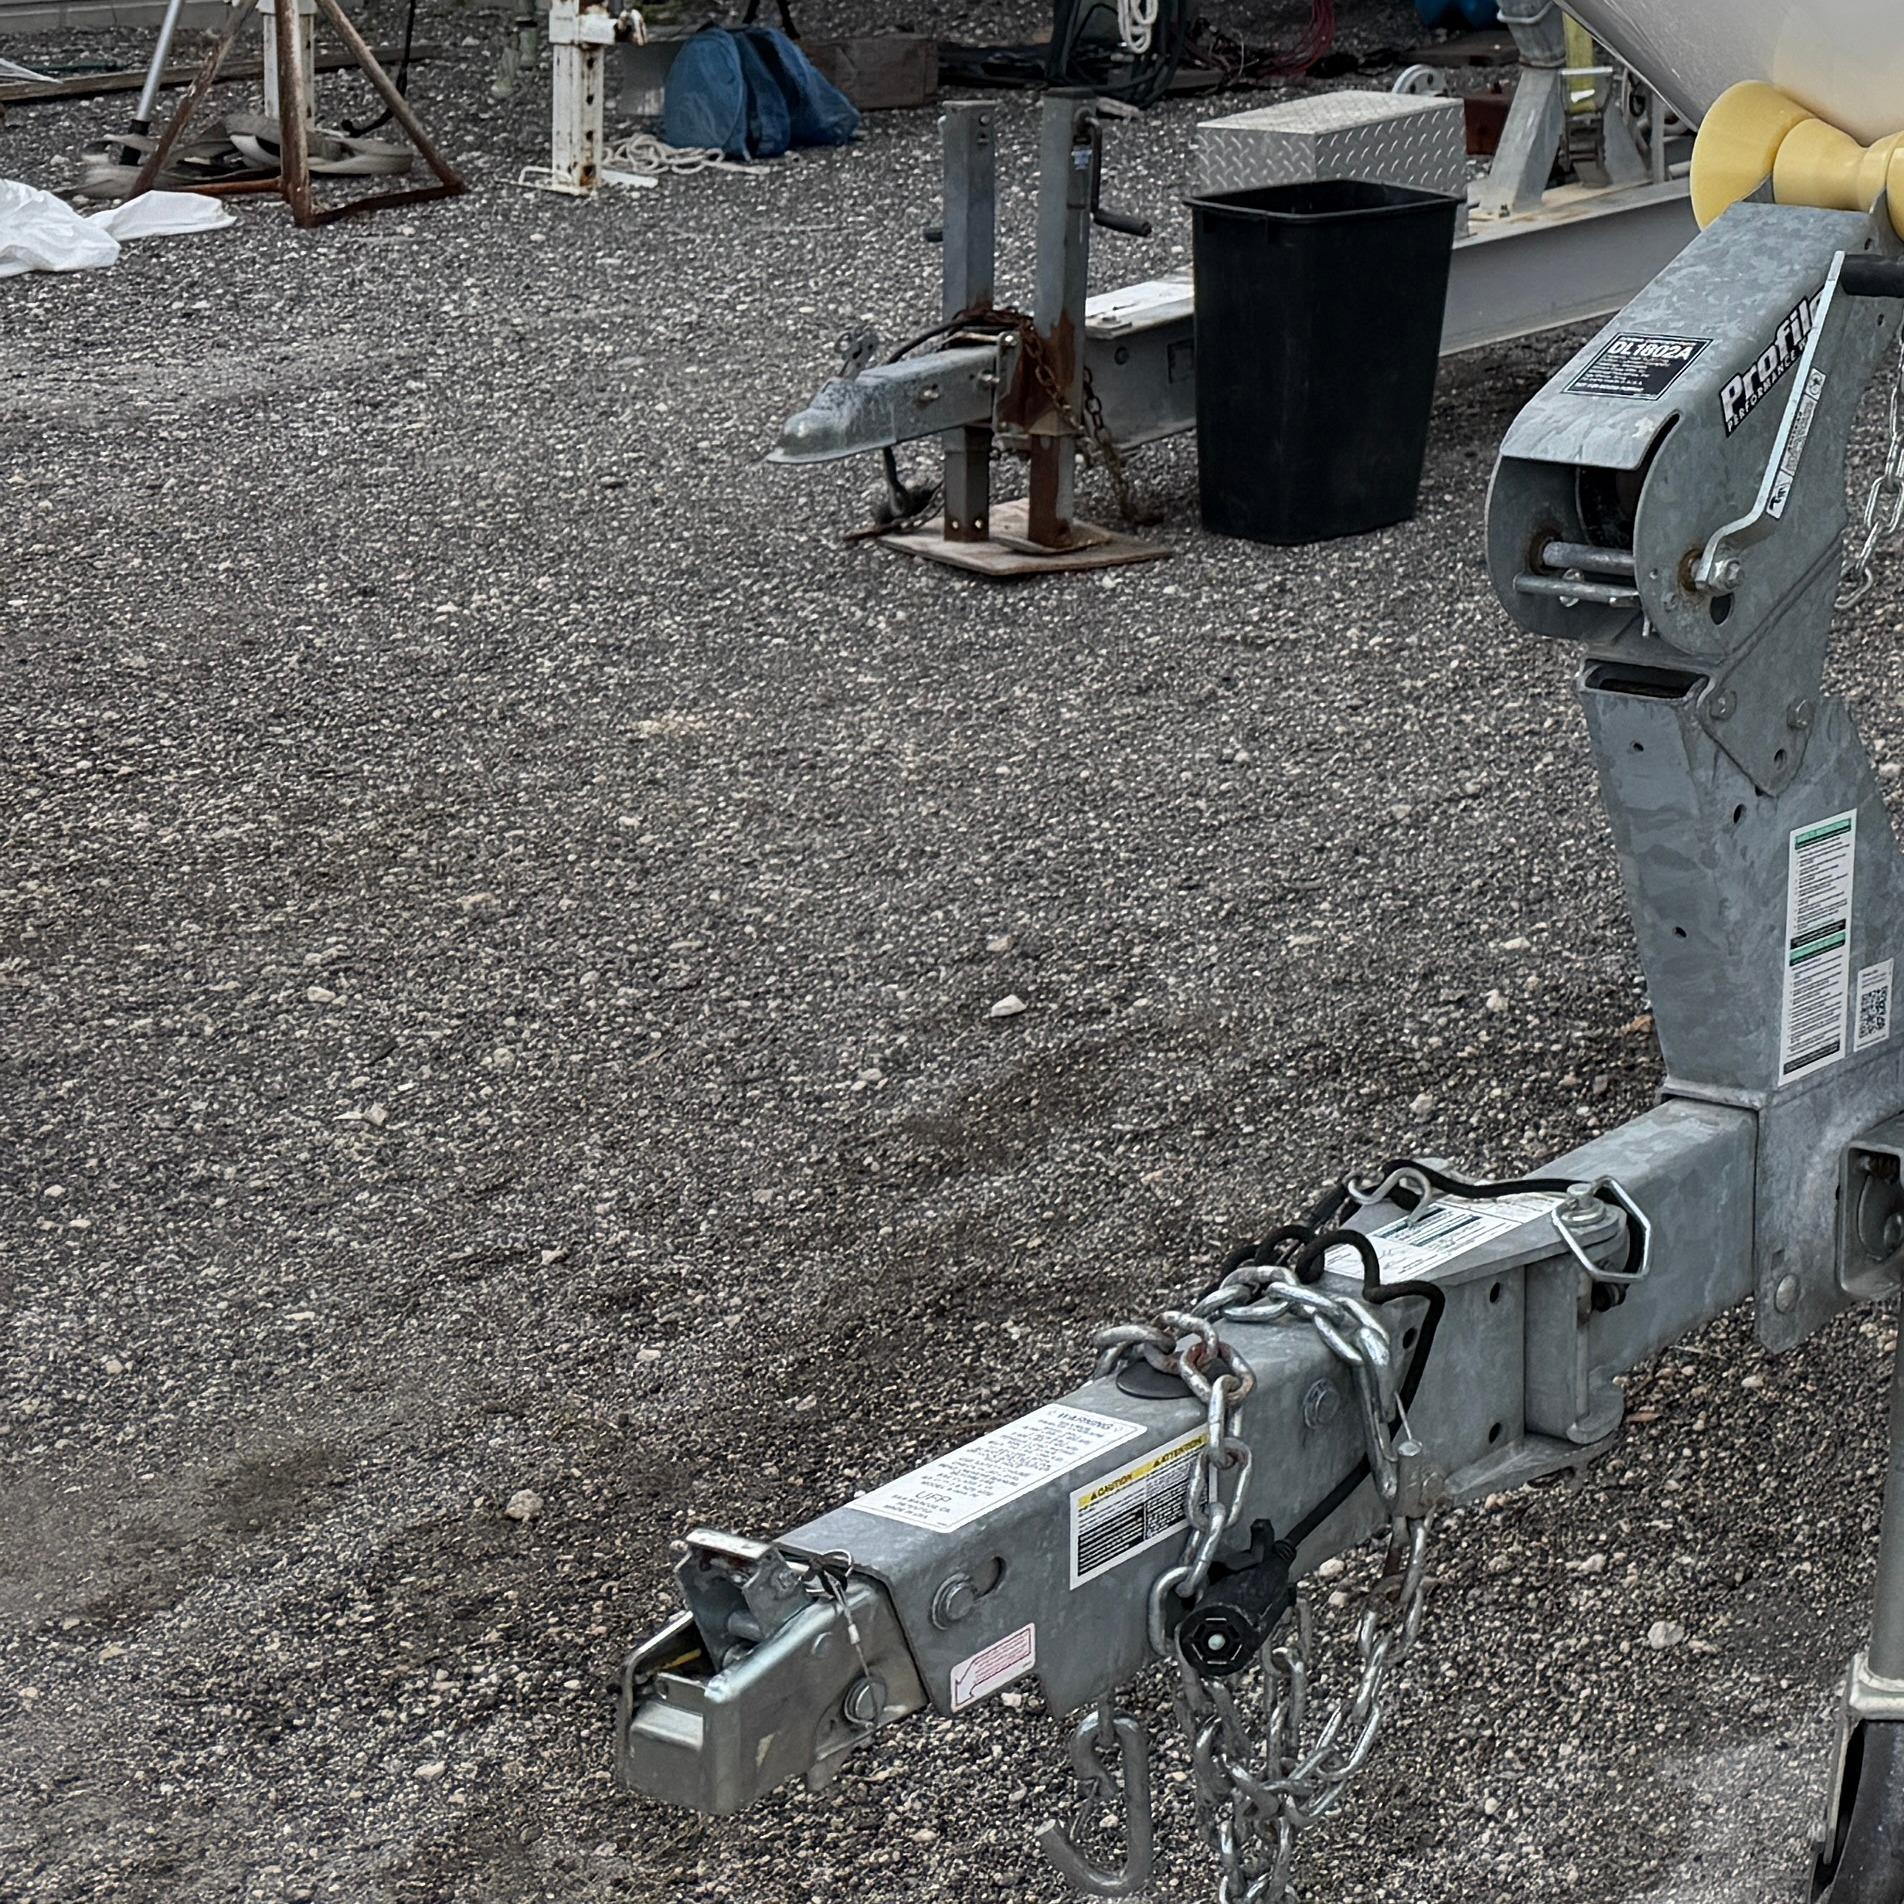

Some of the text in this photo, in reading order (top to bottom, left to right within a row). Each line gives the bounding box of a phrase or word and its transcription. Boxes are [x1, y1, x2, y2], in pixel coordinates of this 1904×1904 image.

[1607, 341, 1694, 360] DL1802A
[1727, 351, 1797, 434] PERFORMANCE
[1097, 1472, 1133, 1497] CAUTION
[915, 1490, 952, 1502] UFP
